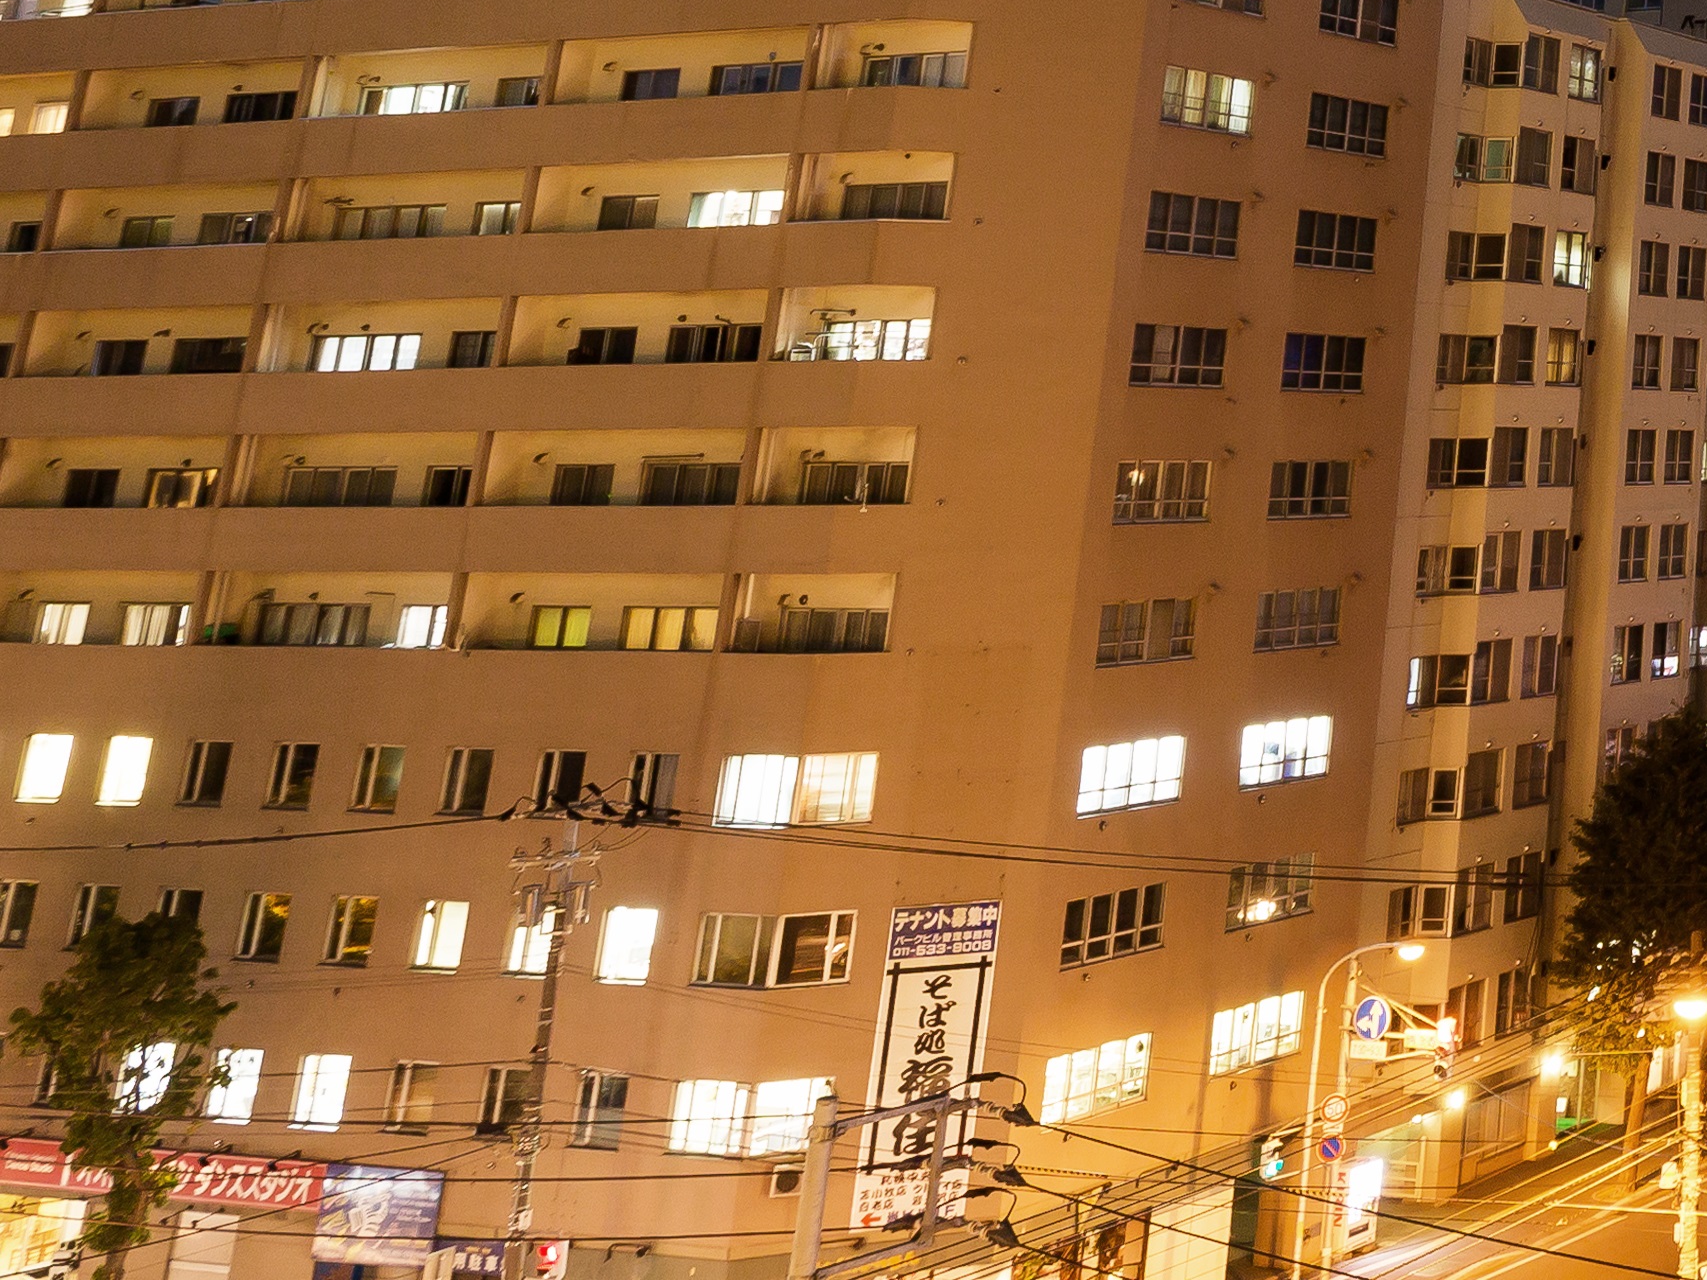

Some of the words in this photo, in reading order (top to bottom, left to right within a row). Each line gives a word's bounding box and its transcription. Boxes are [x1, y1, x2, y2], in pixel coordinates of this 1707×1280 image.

[895, 905, 998, 932] テナント募集中
[1327, 1102, 1343, 1116] 50
